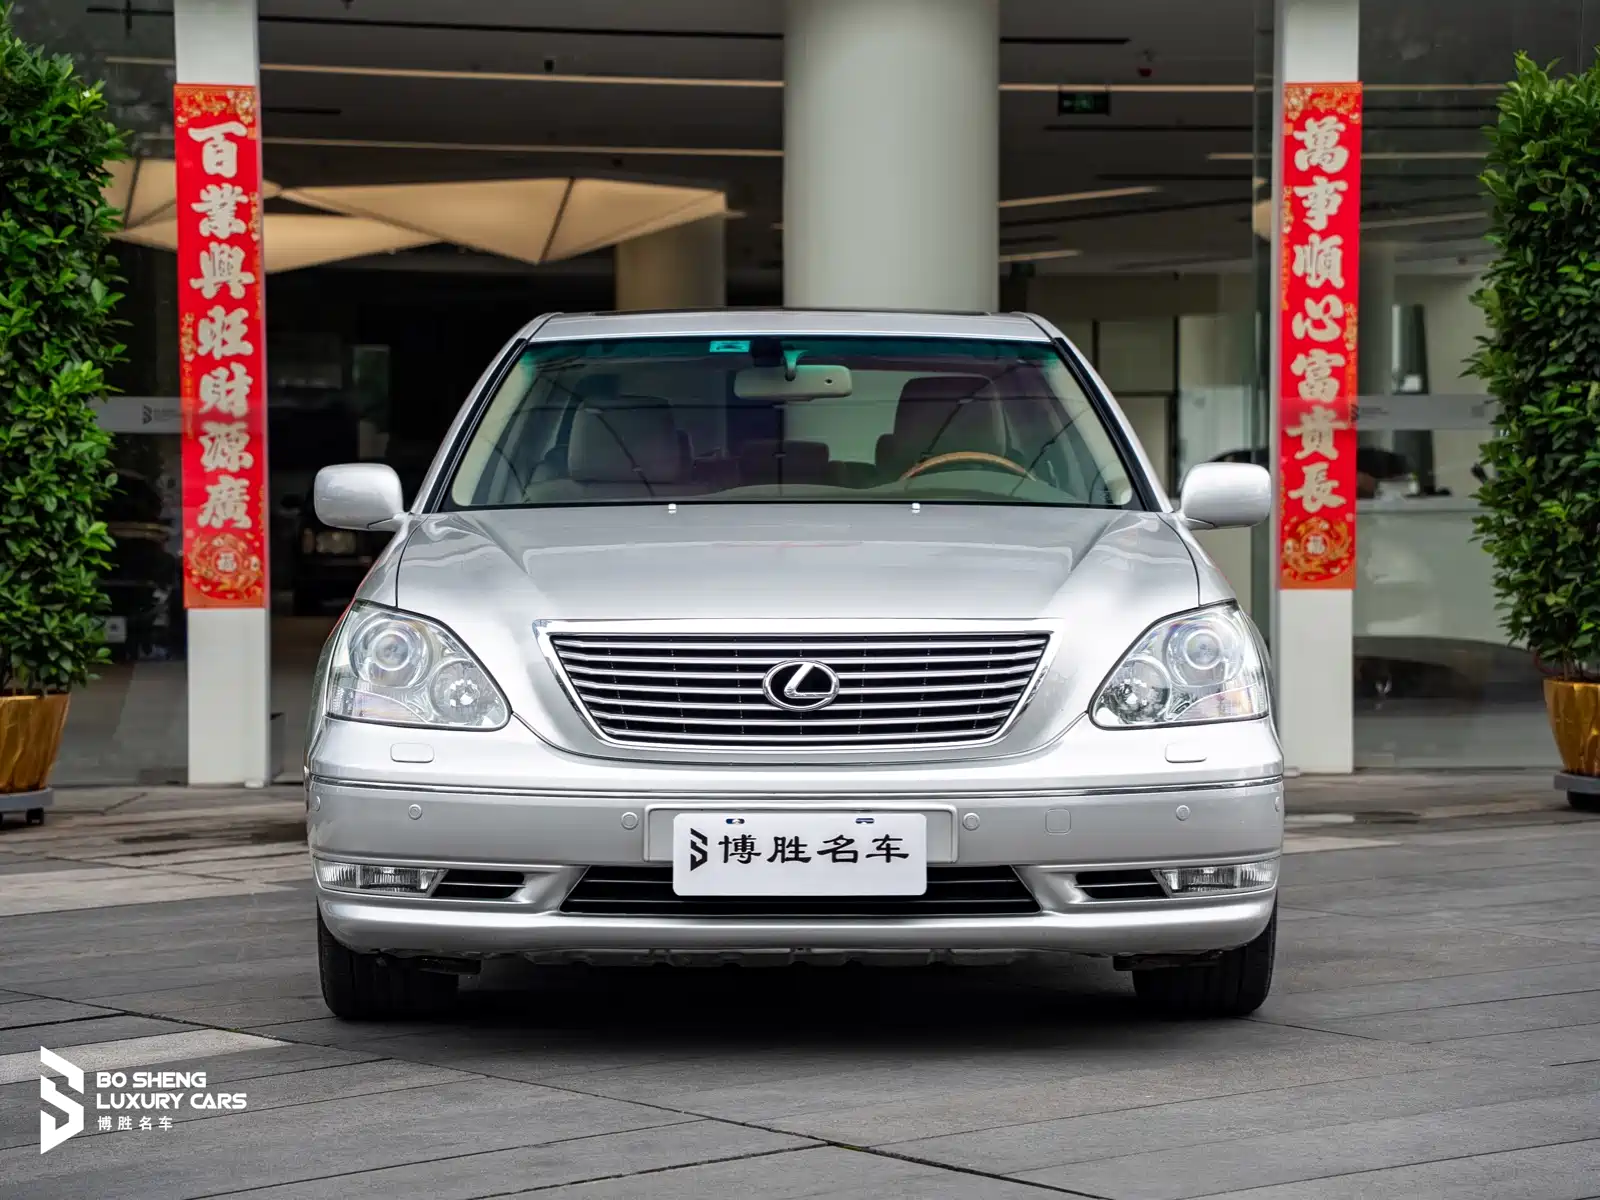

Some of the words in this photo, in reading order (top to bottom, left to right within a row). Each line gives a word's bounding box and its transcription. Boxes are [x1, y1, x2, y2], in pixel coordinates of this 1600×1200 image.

[188, 120, 255, 529] 百業興旺財源廣
[1286, 115, 1349, 513] 萬事順心富貴長
[718, 833, 910, 865] 博胜名车
